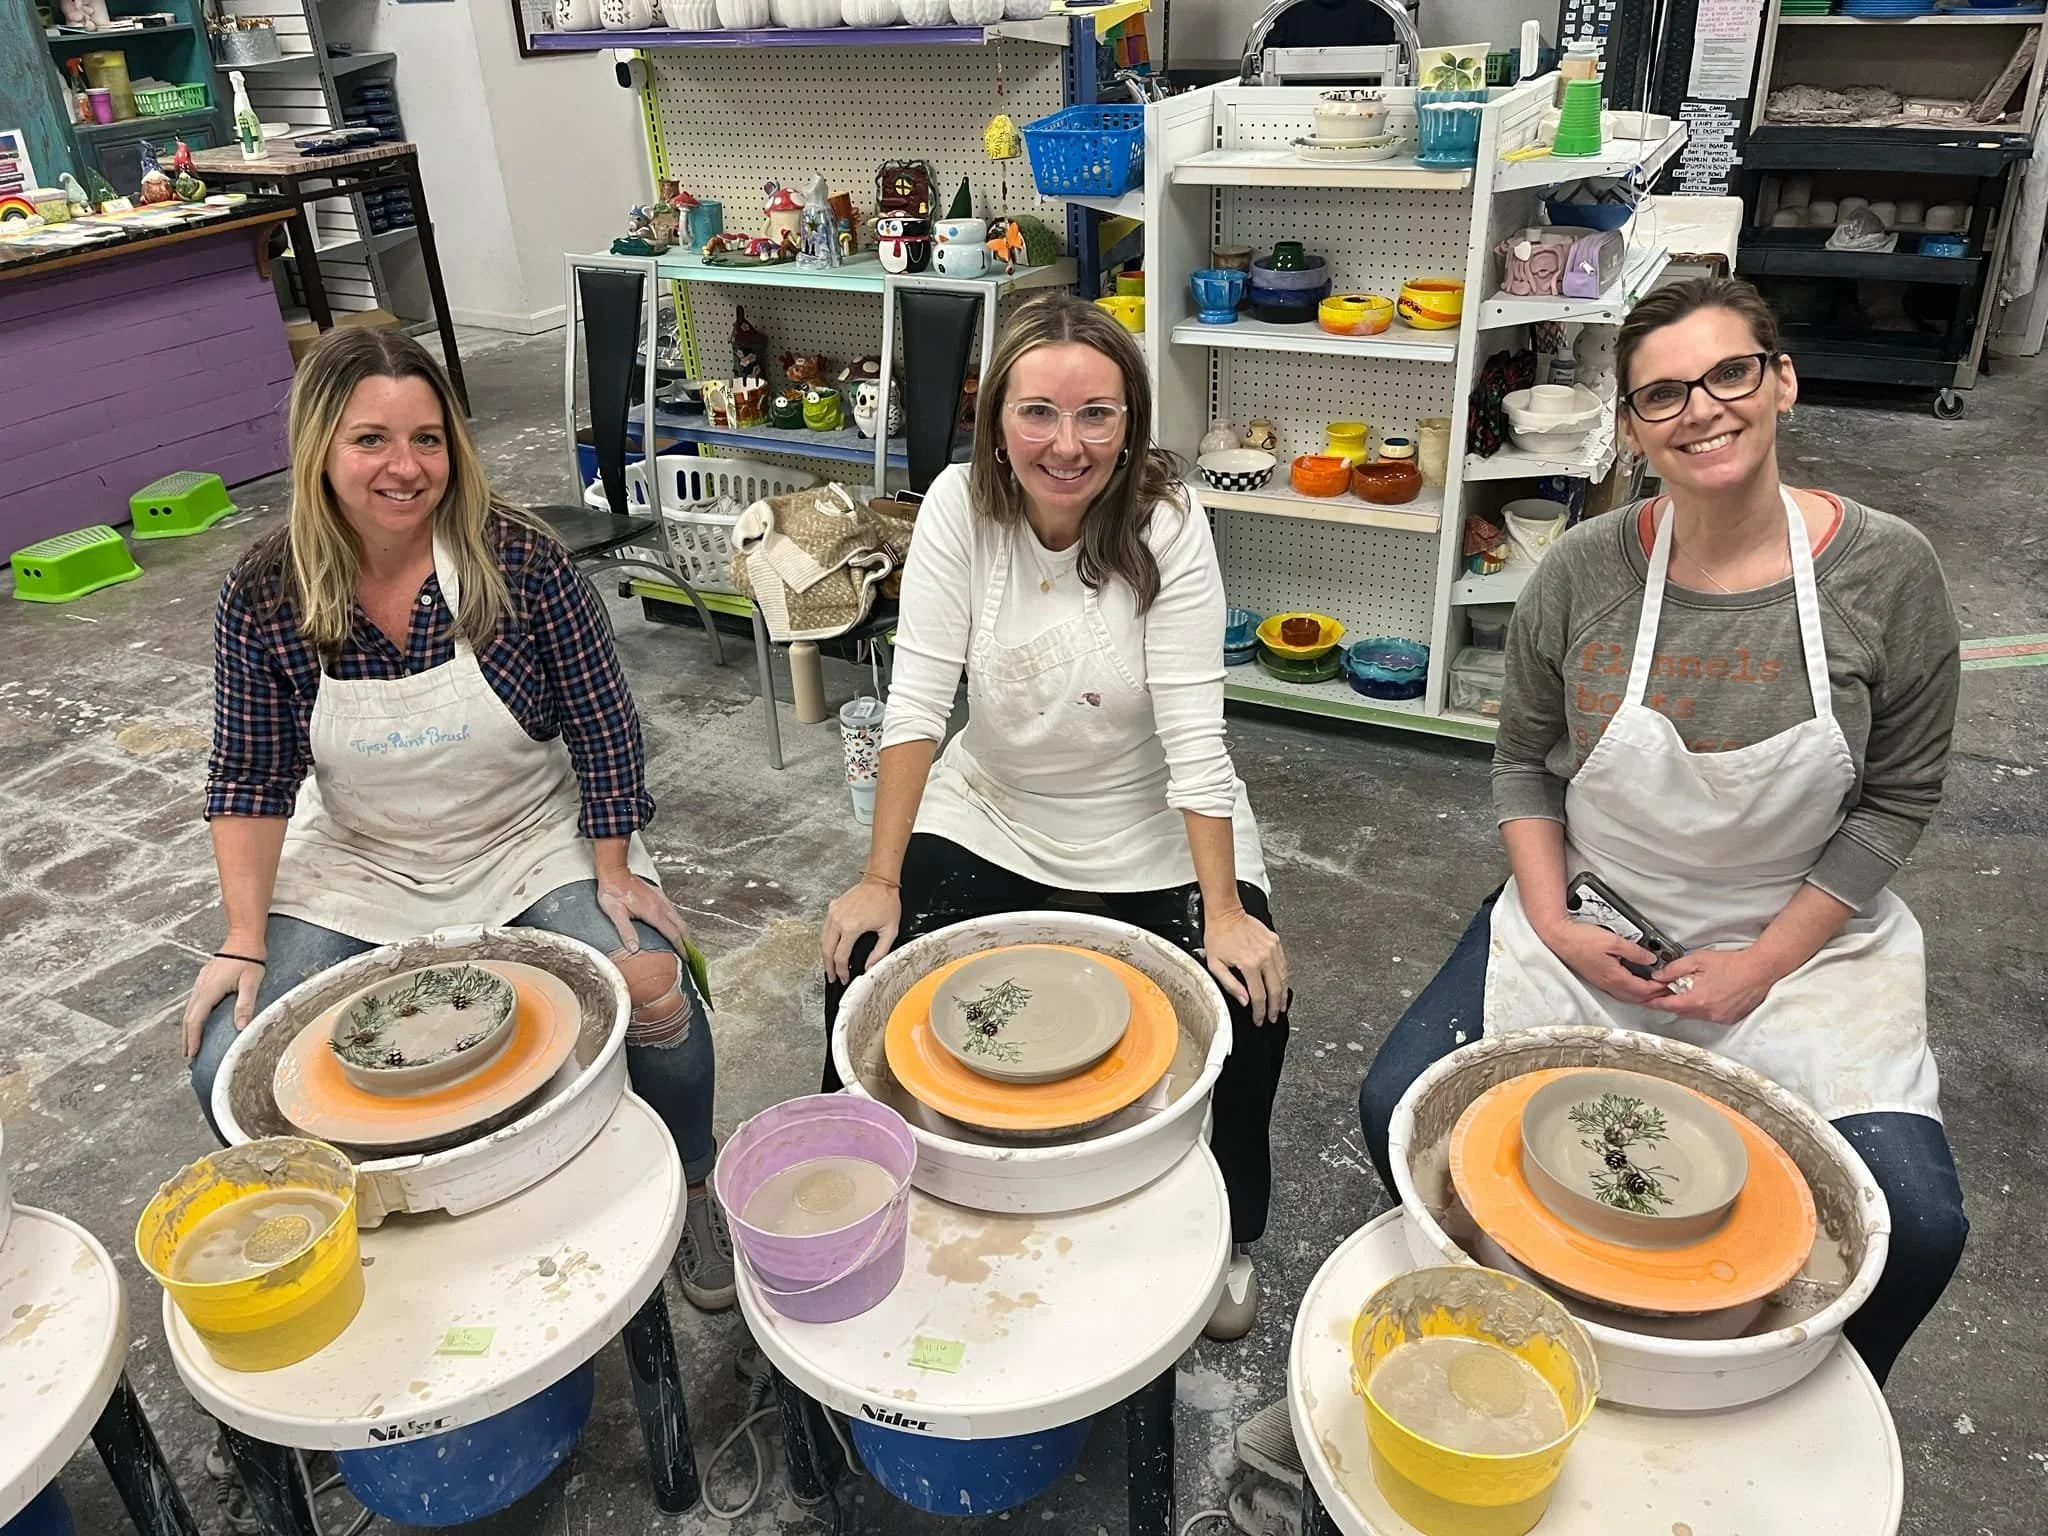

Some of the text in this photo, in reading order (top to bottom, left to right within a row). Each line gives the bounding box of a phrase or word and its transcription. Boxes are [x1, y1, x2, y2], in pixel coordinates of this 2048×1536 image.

[1578, 640, 1783, 682] flnnels
[1576, 683, 1698, 721] bots
[350, 723, 472, 758] Tipsy Paint Brush
[859, 1402, 936, 1432] Nidec
